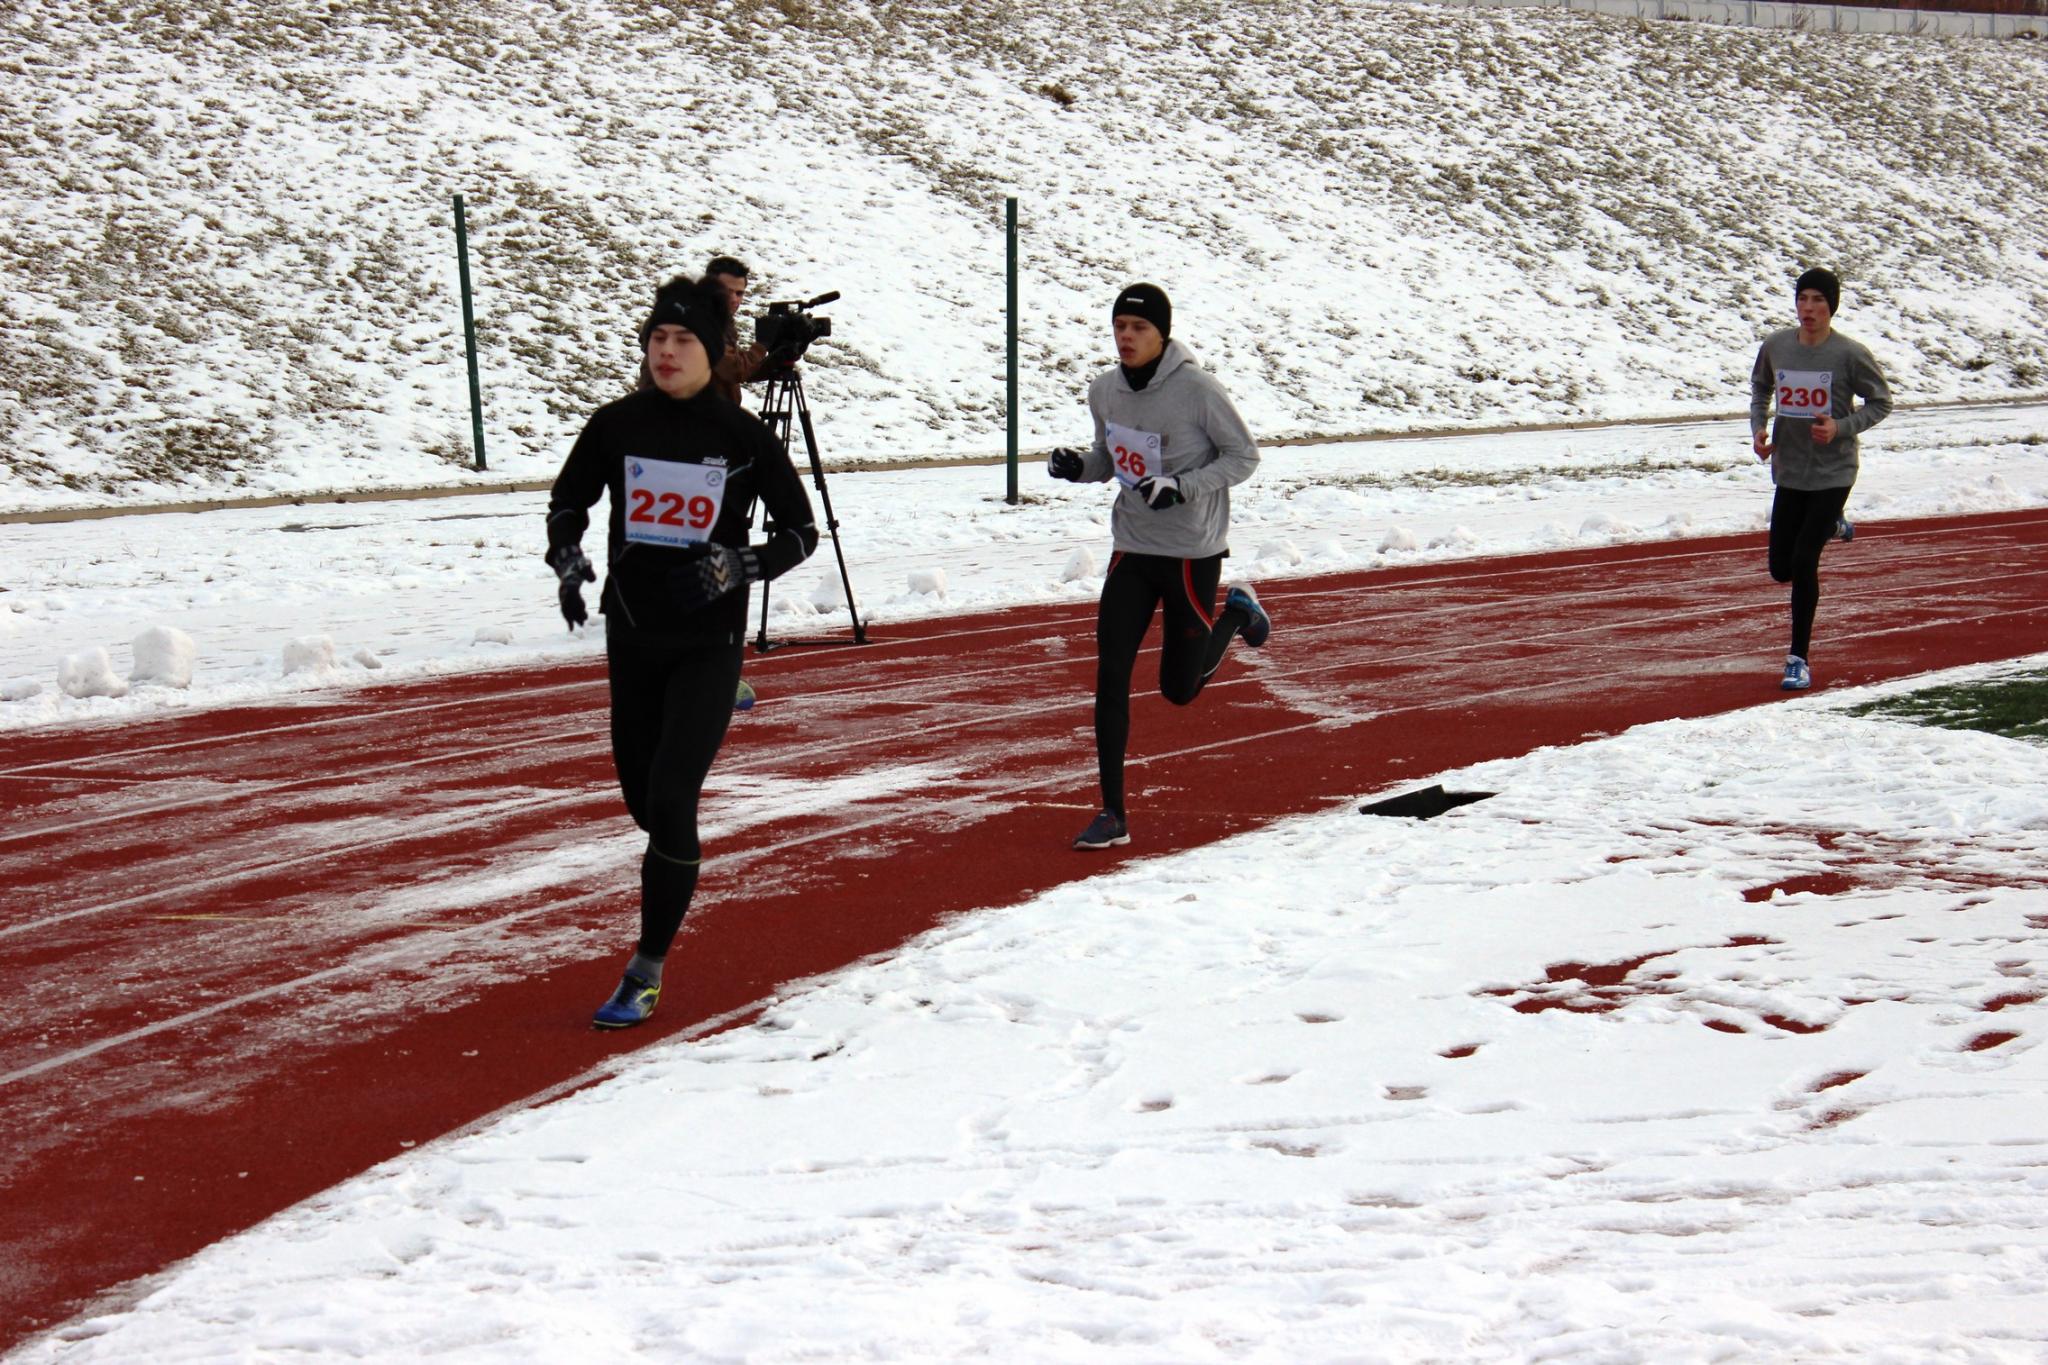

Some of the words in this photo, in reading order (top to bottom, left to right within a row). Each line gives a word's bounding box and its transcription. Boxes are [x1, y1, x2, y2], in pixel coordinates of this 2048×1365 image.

[1779, 386, 1828, 407] 230
[1114, 446, 1146, 477] 26
[629, 488, 715, 529] 229
